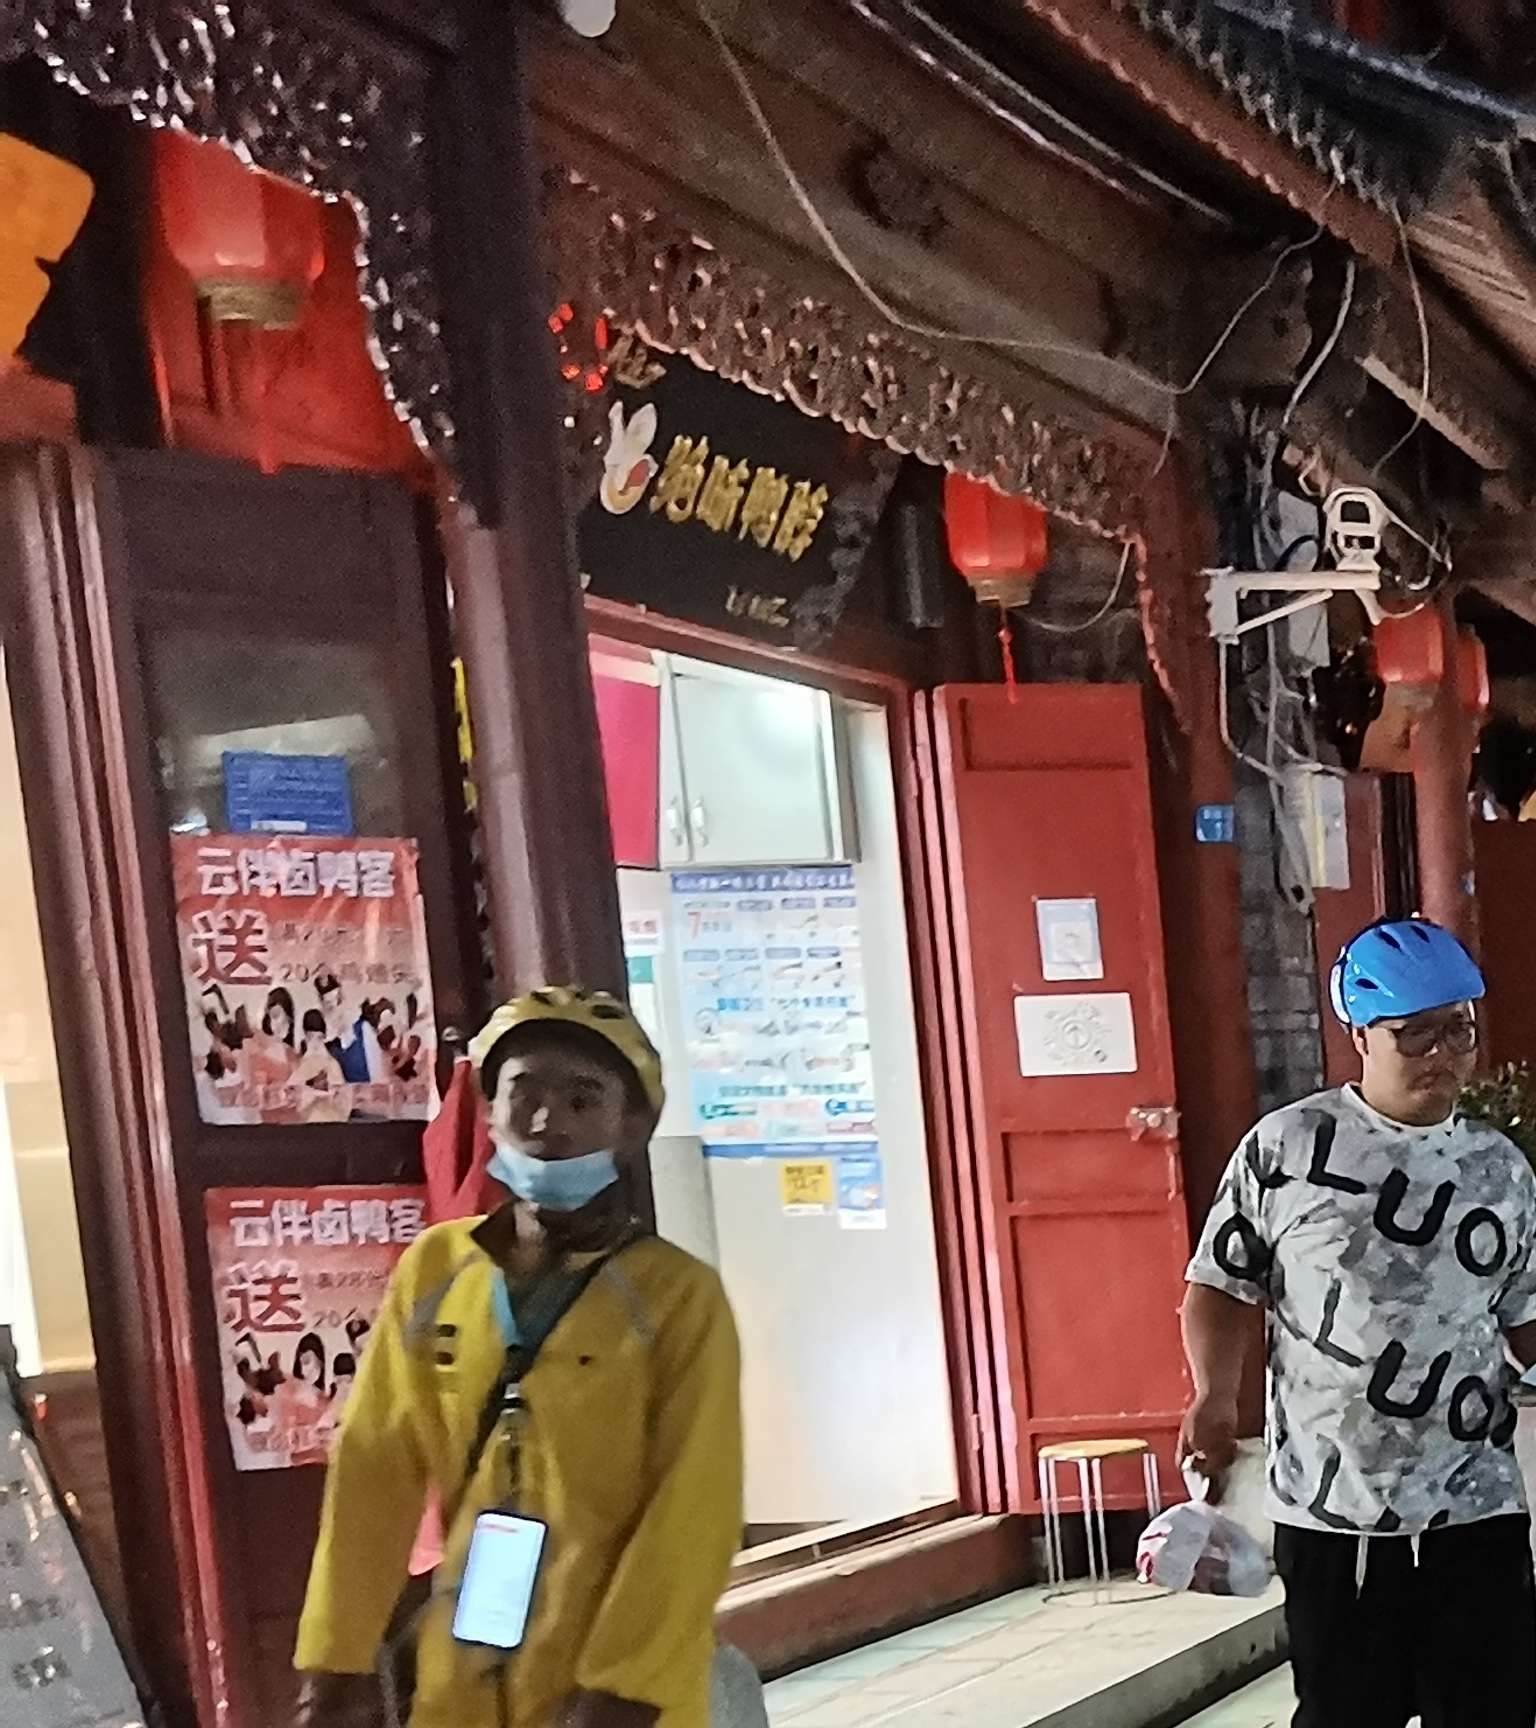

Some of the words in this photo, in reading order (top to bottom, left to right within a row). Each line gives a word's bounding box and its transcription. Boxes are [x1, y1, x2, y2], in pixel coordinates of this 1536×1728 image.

[191, 907, 273, 986] 送
[1302, 1109, 1508, 1278] LUO
[226, 1259, 305, 1334] 送
[1312, 1276, 1498, 1442] LUO
